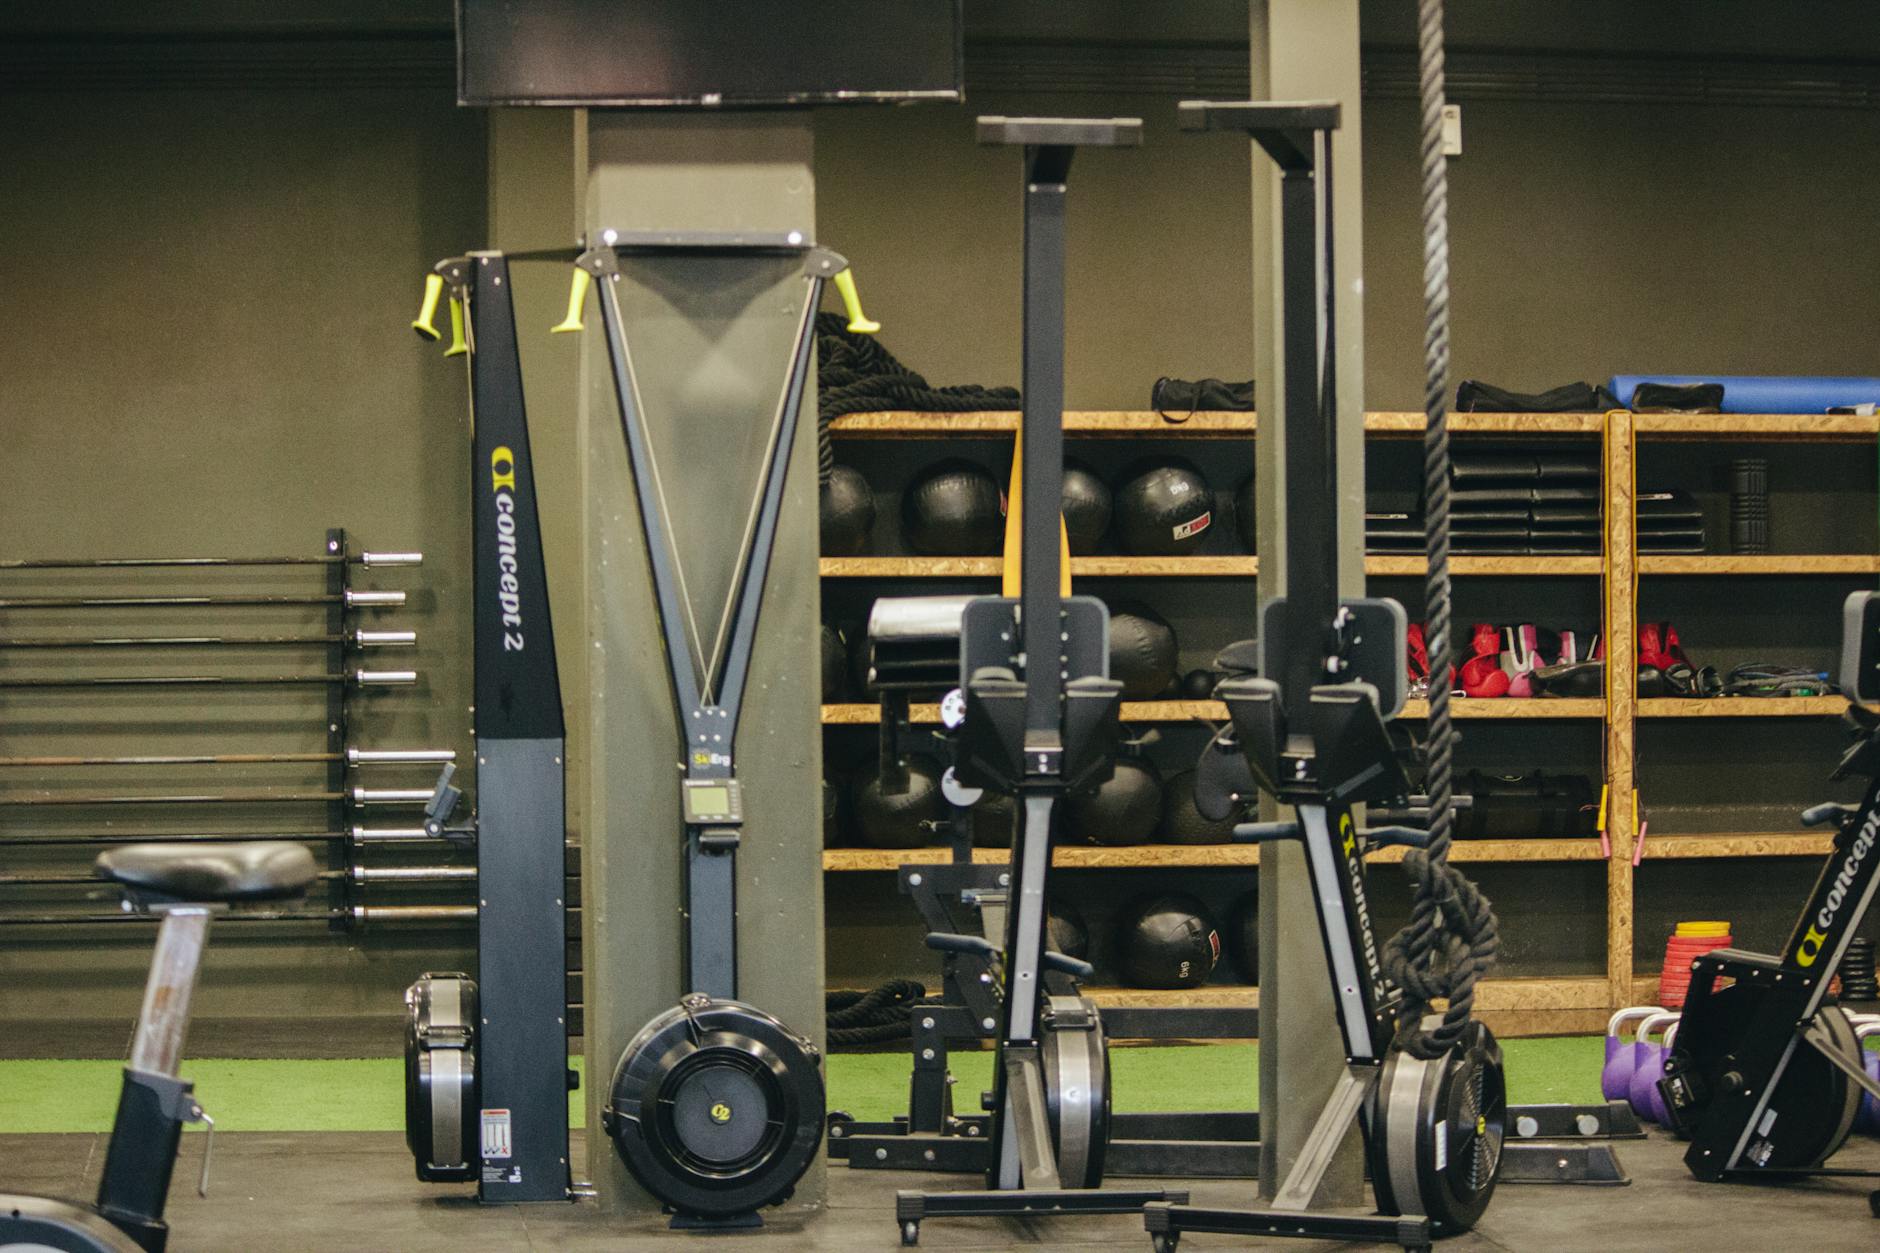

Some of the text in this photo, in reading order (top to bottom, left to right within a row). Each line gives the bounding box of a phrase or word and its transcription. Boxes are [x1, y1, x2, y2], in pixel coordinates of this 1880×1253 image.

[495, 492, 525, 651] concept 2
[1348, 856, 1385, 1001] concept 2
[1818, 809, 1880, 928] concept
[1178, 961, 1191, 978] 6kg
